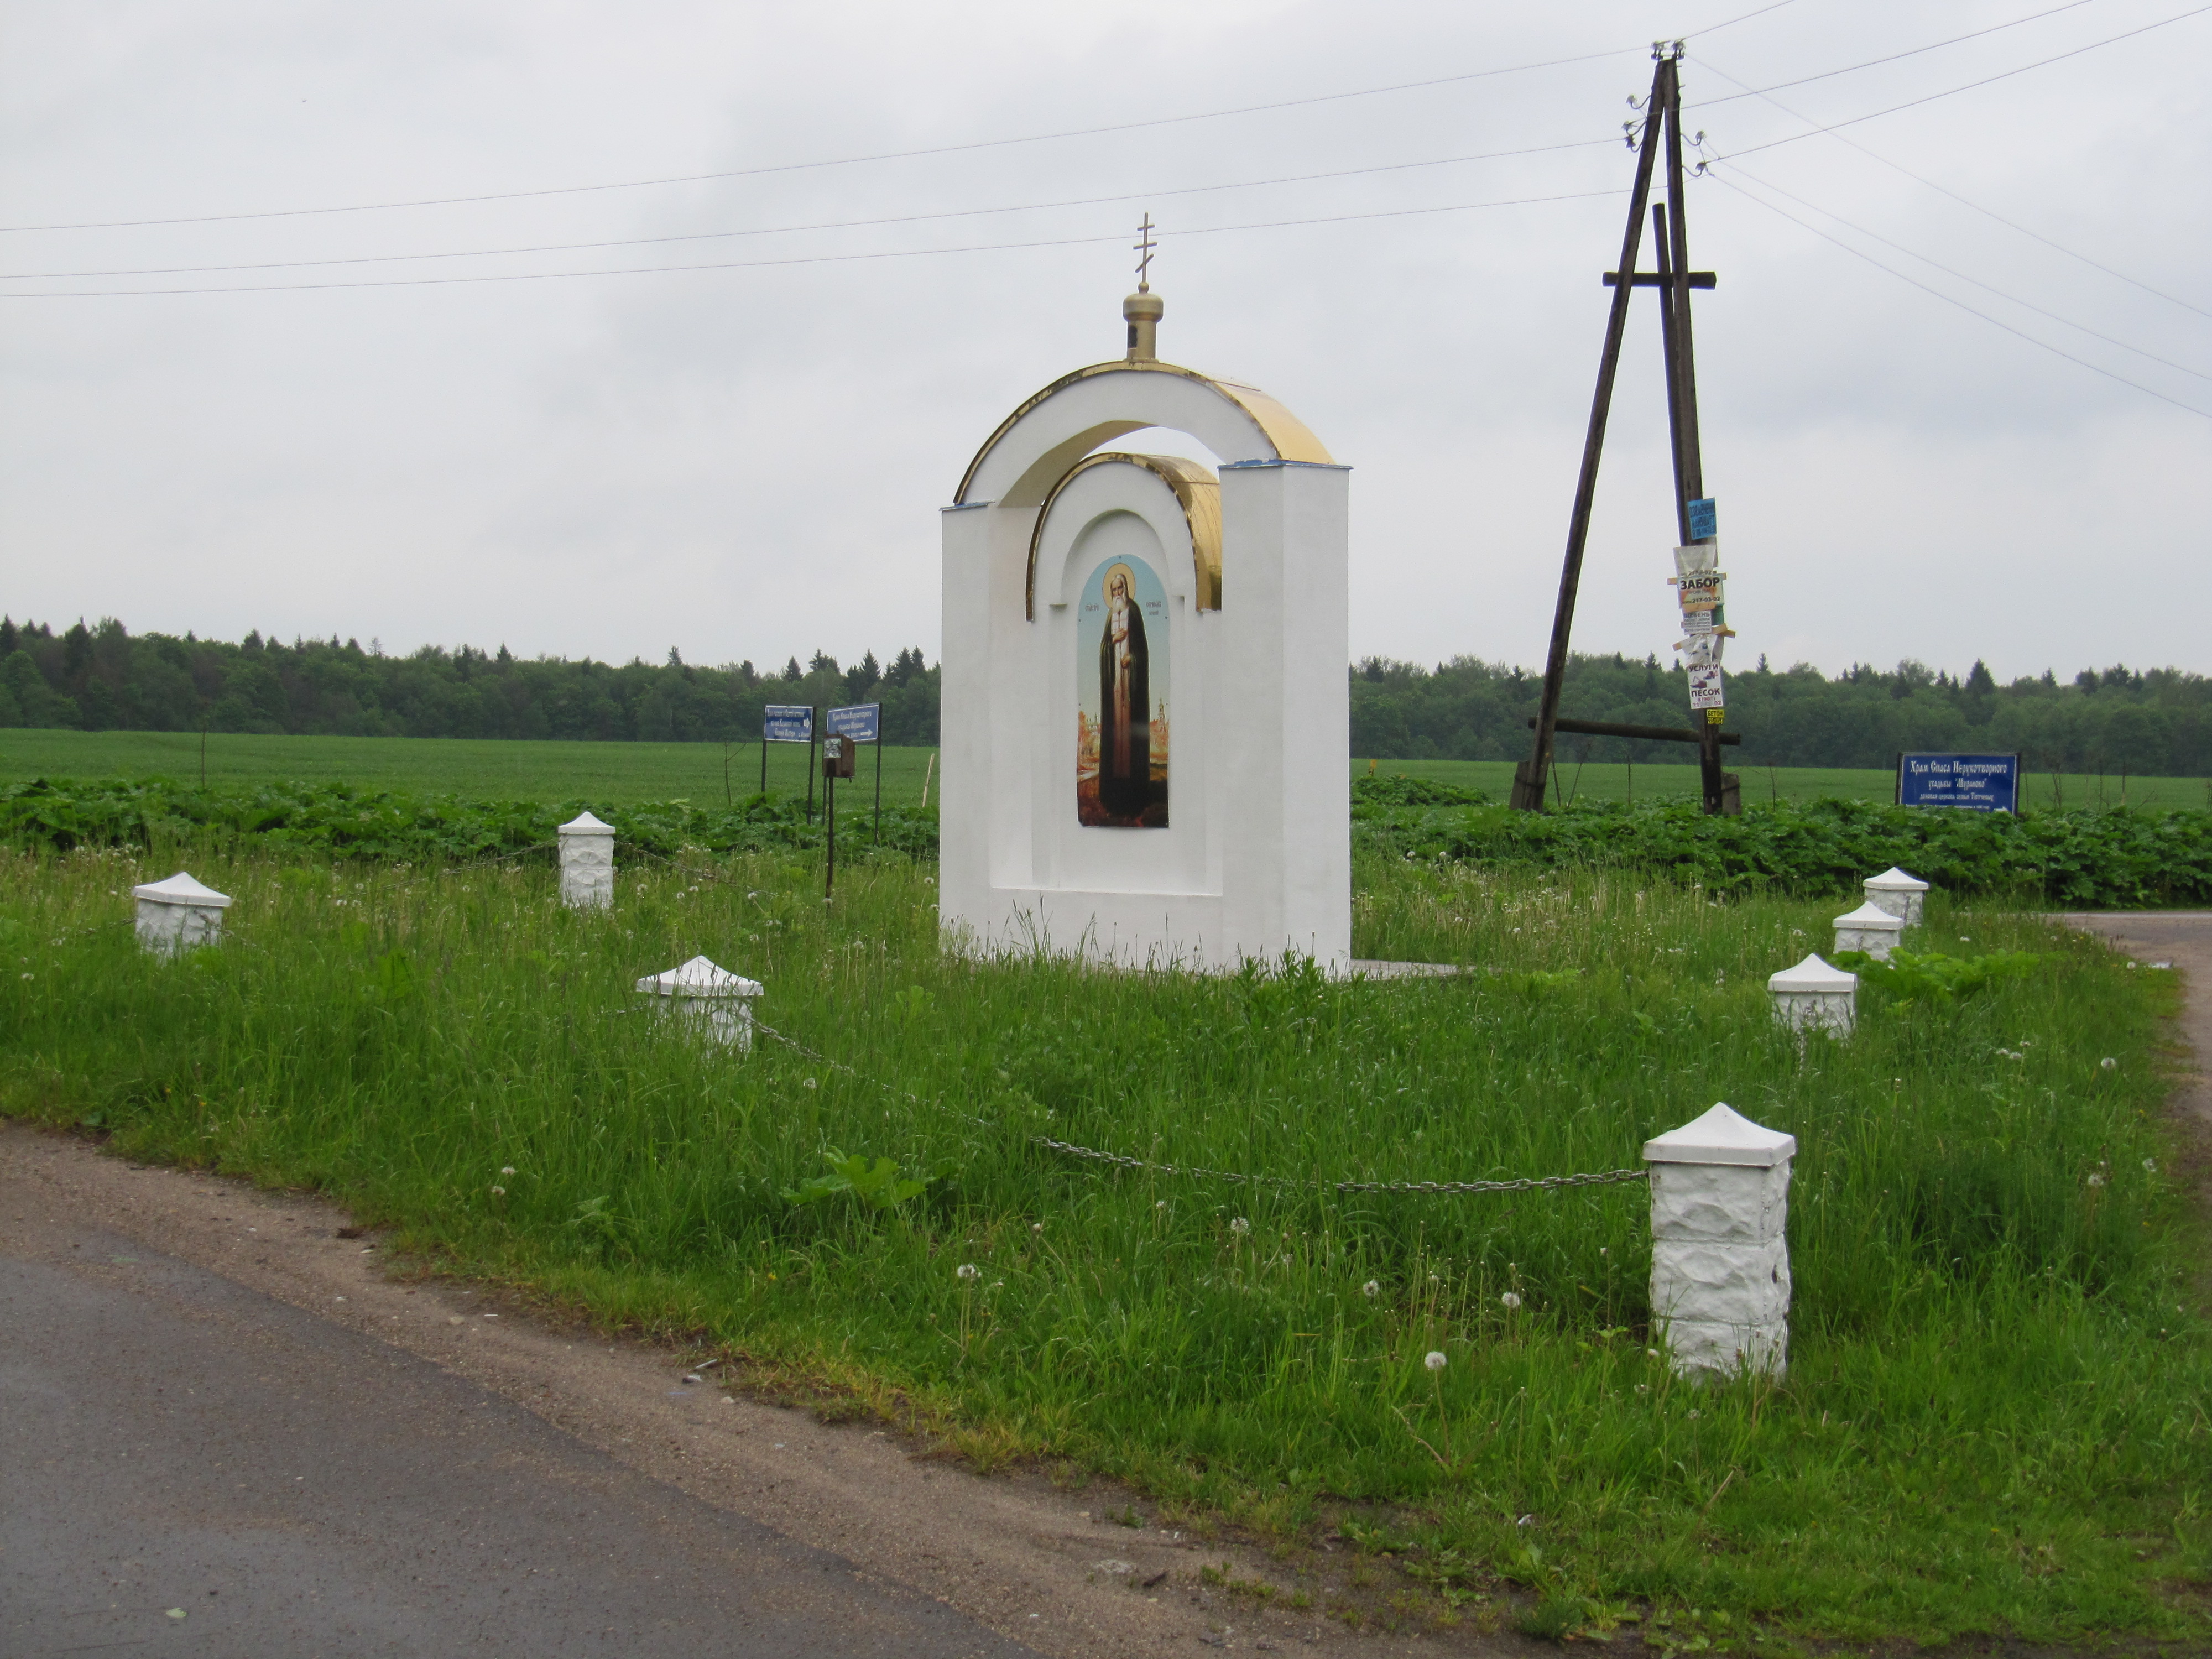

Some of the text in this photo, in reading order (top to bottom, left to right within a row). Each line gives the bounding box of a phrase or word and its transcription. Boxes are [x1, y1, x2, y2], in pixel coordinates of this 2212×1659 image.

[1681, 577, 1719, 590] ЗАБОР
[1692, 688, 1720, 697] ПЕСОК
[1910, 760, 2007, 777] Храм Спаса Нерукотворного
